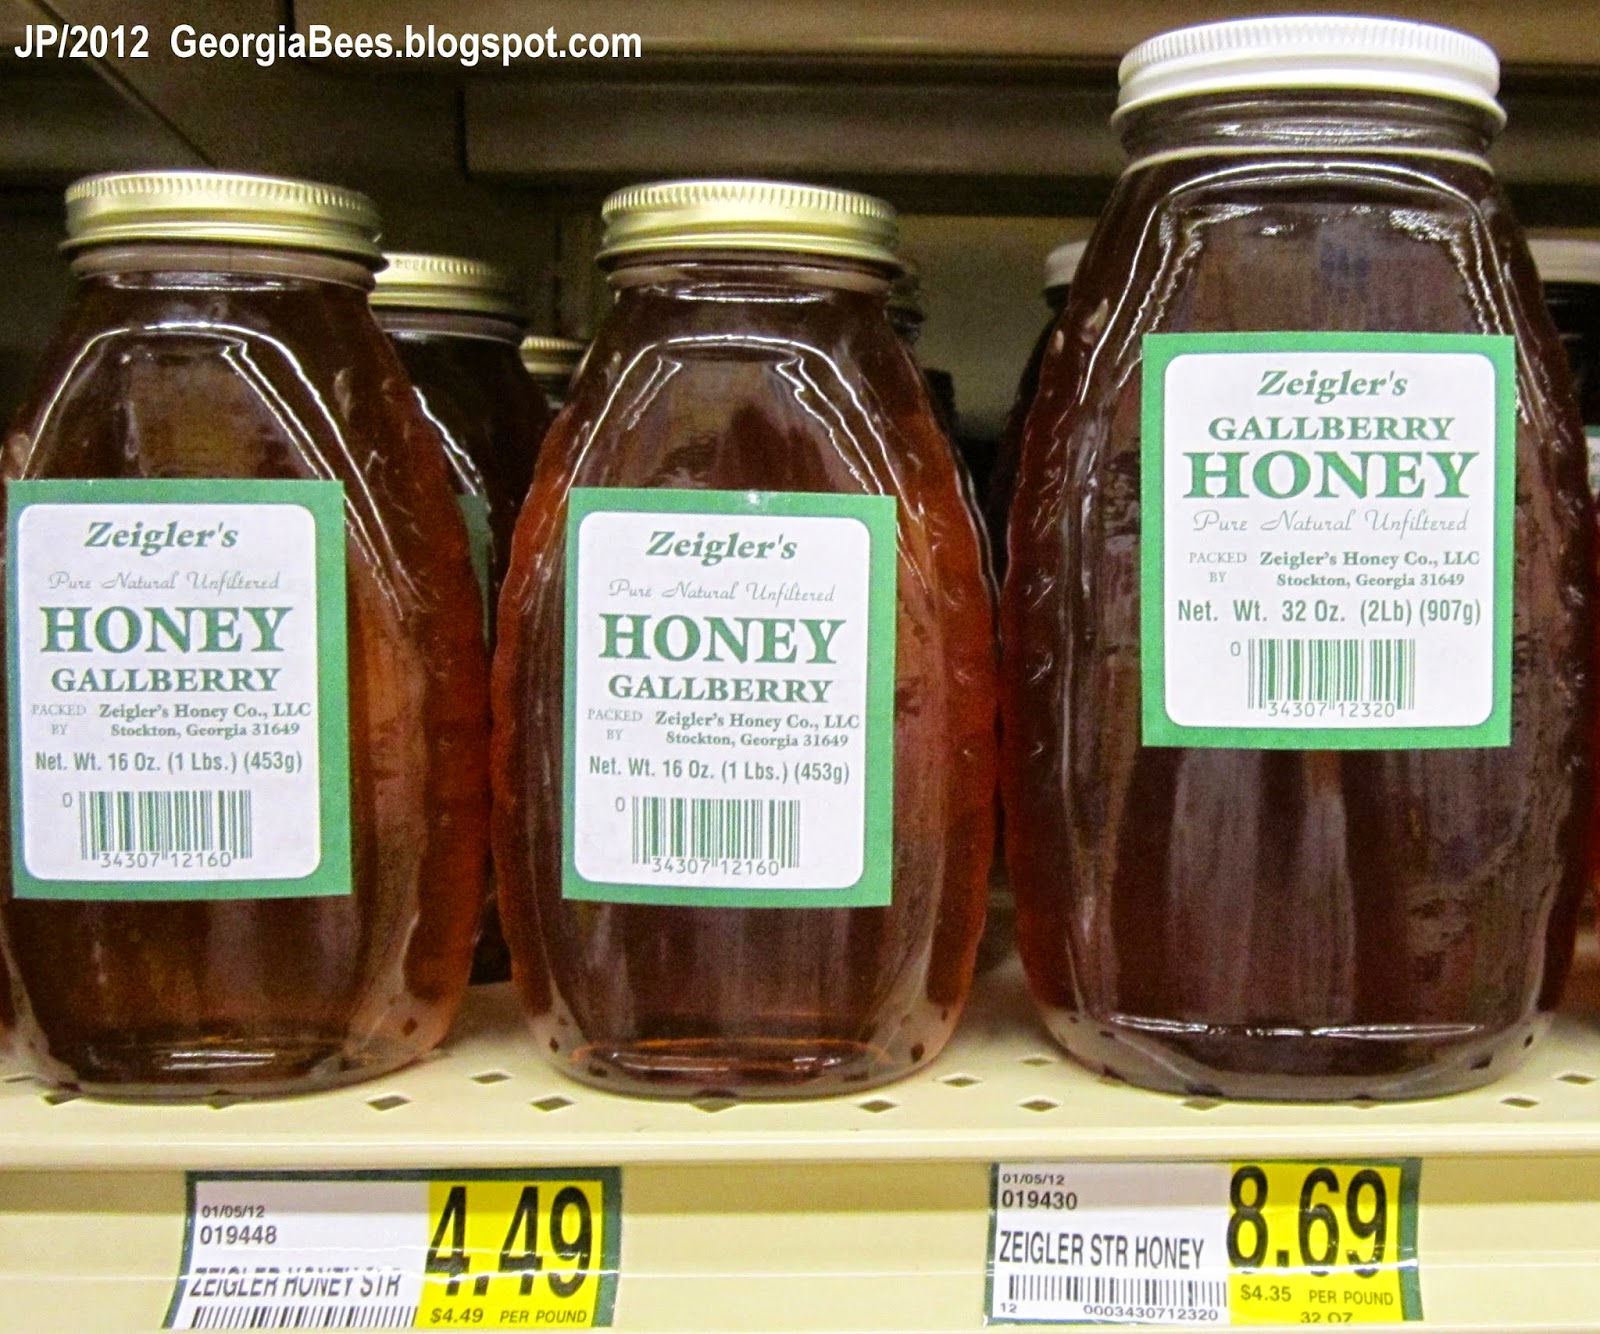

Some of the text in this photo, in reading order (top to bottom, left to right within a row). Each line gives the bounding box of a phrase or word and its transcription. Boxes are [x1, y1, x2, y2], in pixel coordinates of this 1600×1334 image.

[1257, 370, 1408, 404] Zeigler's
[1208, 416, 1455, 441] GALLBERRY
[1182, 449, 1480, 499] HONEY
[1193, 508, 1470, 540] Pure Natural Unfiltered
[84, 521, 239, 556] Zeigler's
[646, 530, 798, 566] Zeigler's
[1189, 552, 1247, 564] PACKED
[1260, 551, 1480, 569] Zeigler's Honey Co., LLC
[48, 571, 280, 596] Pure Natural Unfiltered
[1209, 572, 1227, 583] BY
[1277, 574, 1464, 590] Stockton, Georgia 31649
[609, 579, 835, 608] Pure Natural Unfiltered
[1177, 599, 1481, 626] Net. Wt. 32 Oz. (2Lb) (907g)
[40, 605, 294, 654] HONEY
[598, 613, 847, 665] HONEY
[52, 667, 282, 692] GALLBERRY
[608, 675, 834, 703] GALLBERRY
[32, 704, 86, 716] PACKED
[99, 703, 311, 721] Zeigler's Honey Co., LLC
[587, 709, 643, 722] PACKED
[1268, 702, 1396, 717] 34307 12320
[51, 724, 68, 735] BY
[655, 711, 860, 732] Zeigler's Honey Co., LLC
[111, 724, 300, 740] Stockton, Georgia 31649
[607, 729, 623, 741] BY
[666, 733, 848, 750] Stockton, Georgia 31649
[35, 751, 302, 773] Net. Wt. 16 Oz. (1 Lbs.) (453g)
[590, 756, 850, 783] Net. Wt. 16 Oz. (1 Lbs.) (453g)
[101, 852, 231, 868] 34307 12160
[653, 858, 779, 875] 34307 12160
[1002, 1174, 1065, 1186] 01/05/12
[1002, 1190, 1078, 1210] 019430
[202, 1205, 265, 1219] 01/05/12
[1226, 1166, 1387, 1277] 8.69
[200, 1225, 278, 1245] 019448
[427, 1186, 593, 1298] 4.49
[999, 1231, 1204, 1269] ZEIGLER STR HONEY
[189, 1268, 401, 1297] ZEIGLER HONEY STR
[1240, 1285, 1393, 1305] $4.35 PER POUND
[430, 1307, 587, 1324] $4.49 PER POUND
[1000, 1304, 1219, 1321] 12 0003430712320
